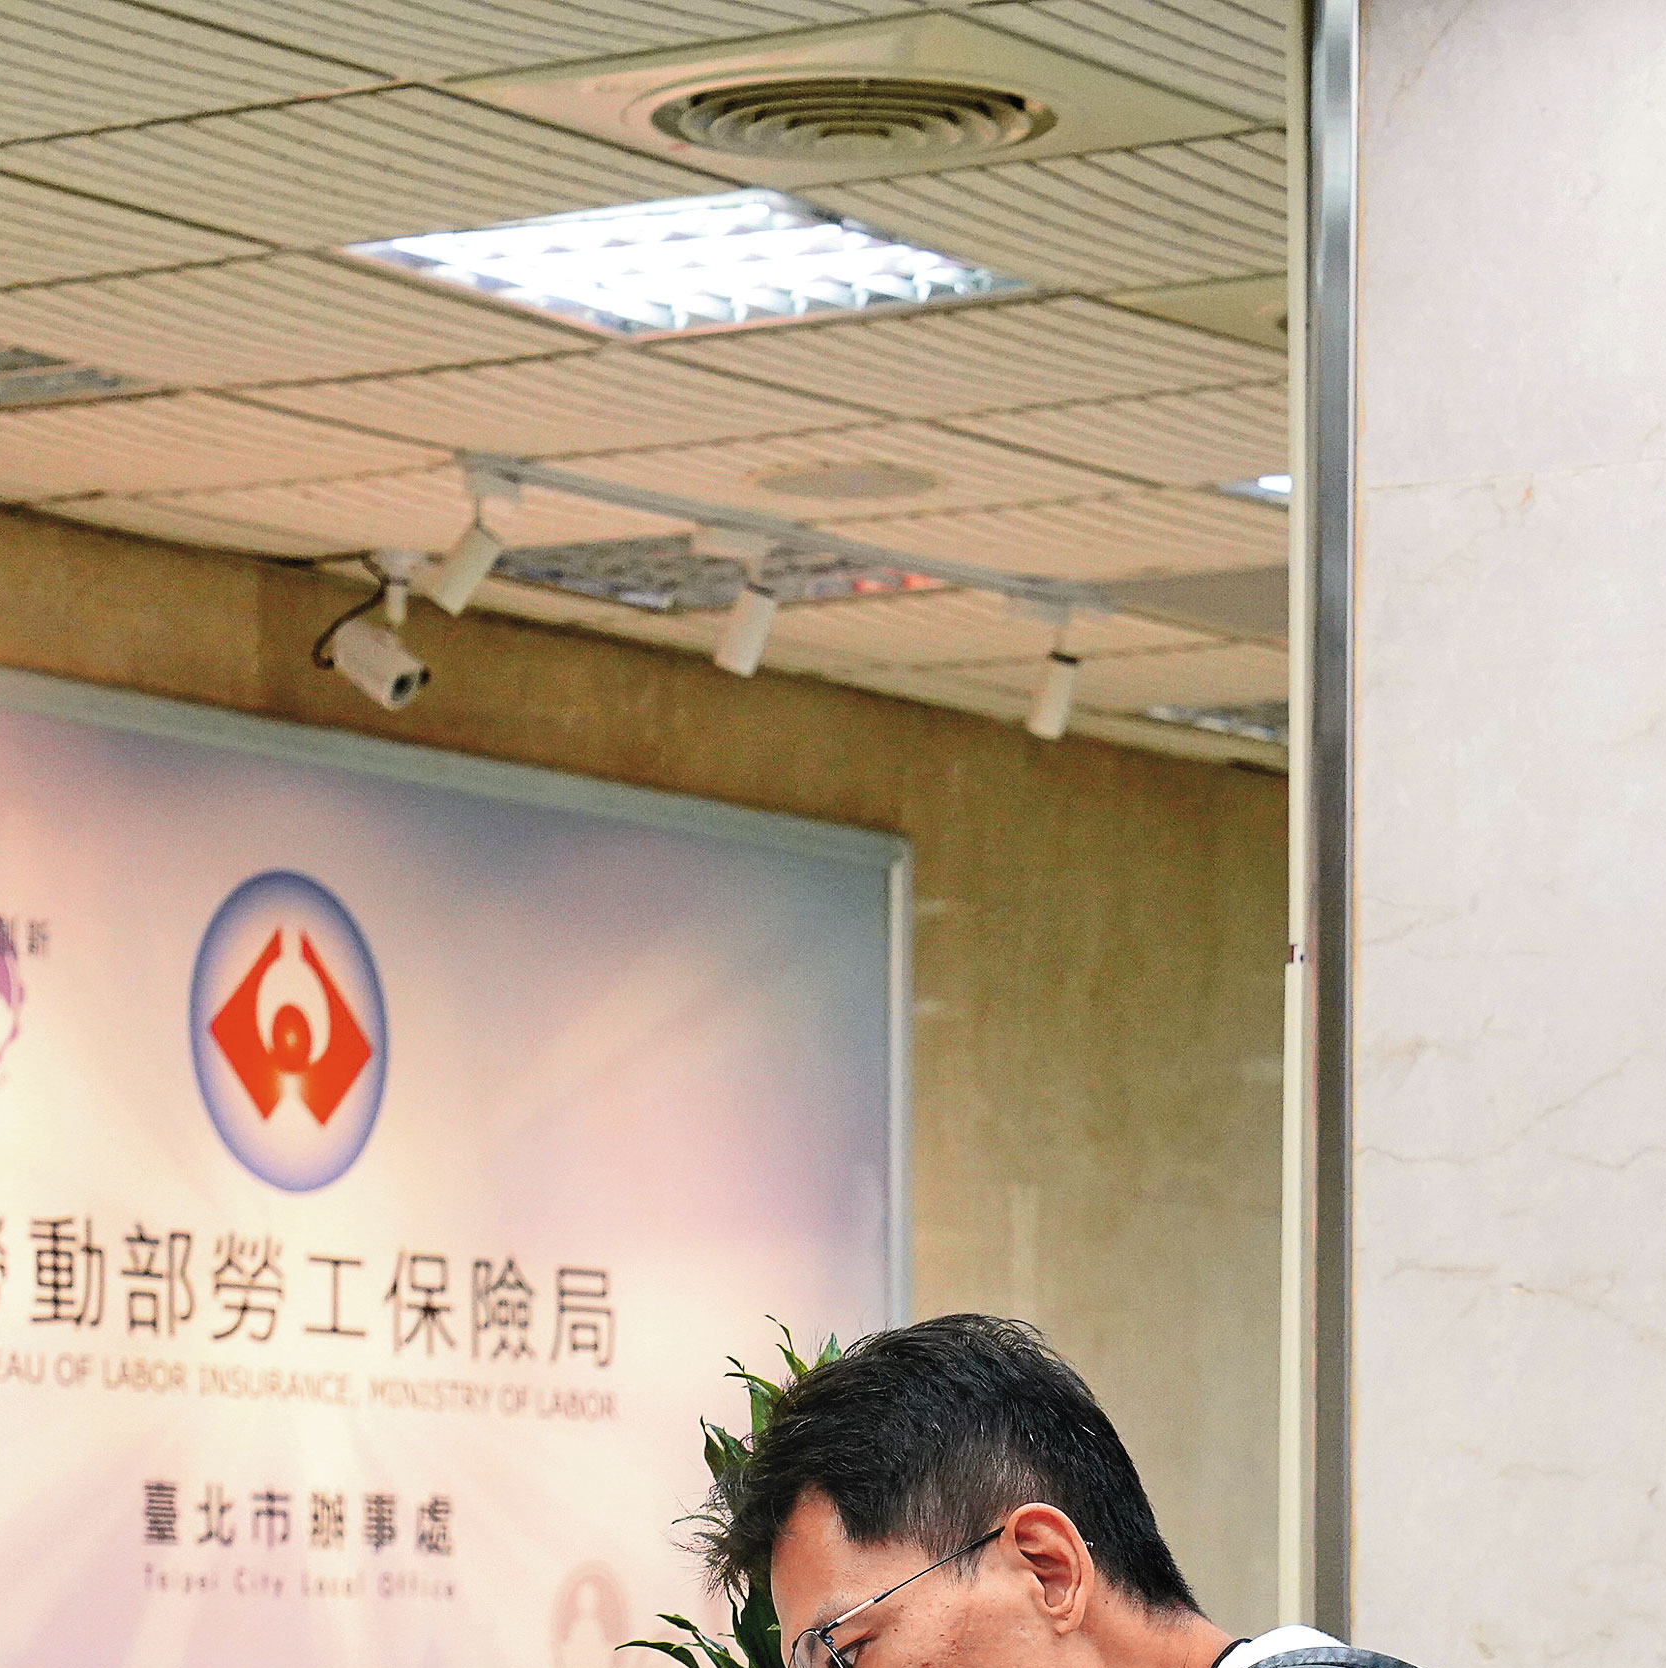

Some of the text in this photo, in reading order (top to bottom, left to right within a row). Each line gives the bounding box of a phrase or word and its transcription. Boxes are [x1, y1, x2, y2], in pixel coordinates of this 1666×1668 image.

[54, 1352, 94, 1388] OF
[101, 1354, 189, 1395] LABOR
[143, 1480, 453, 1556] 臺北市辦事處
